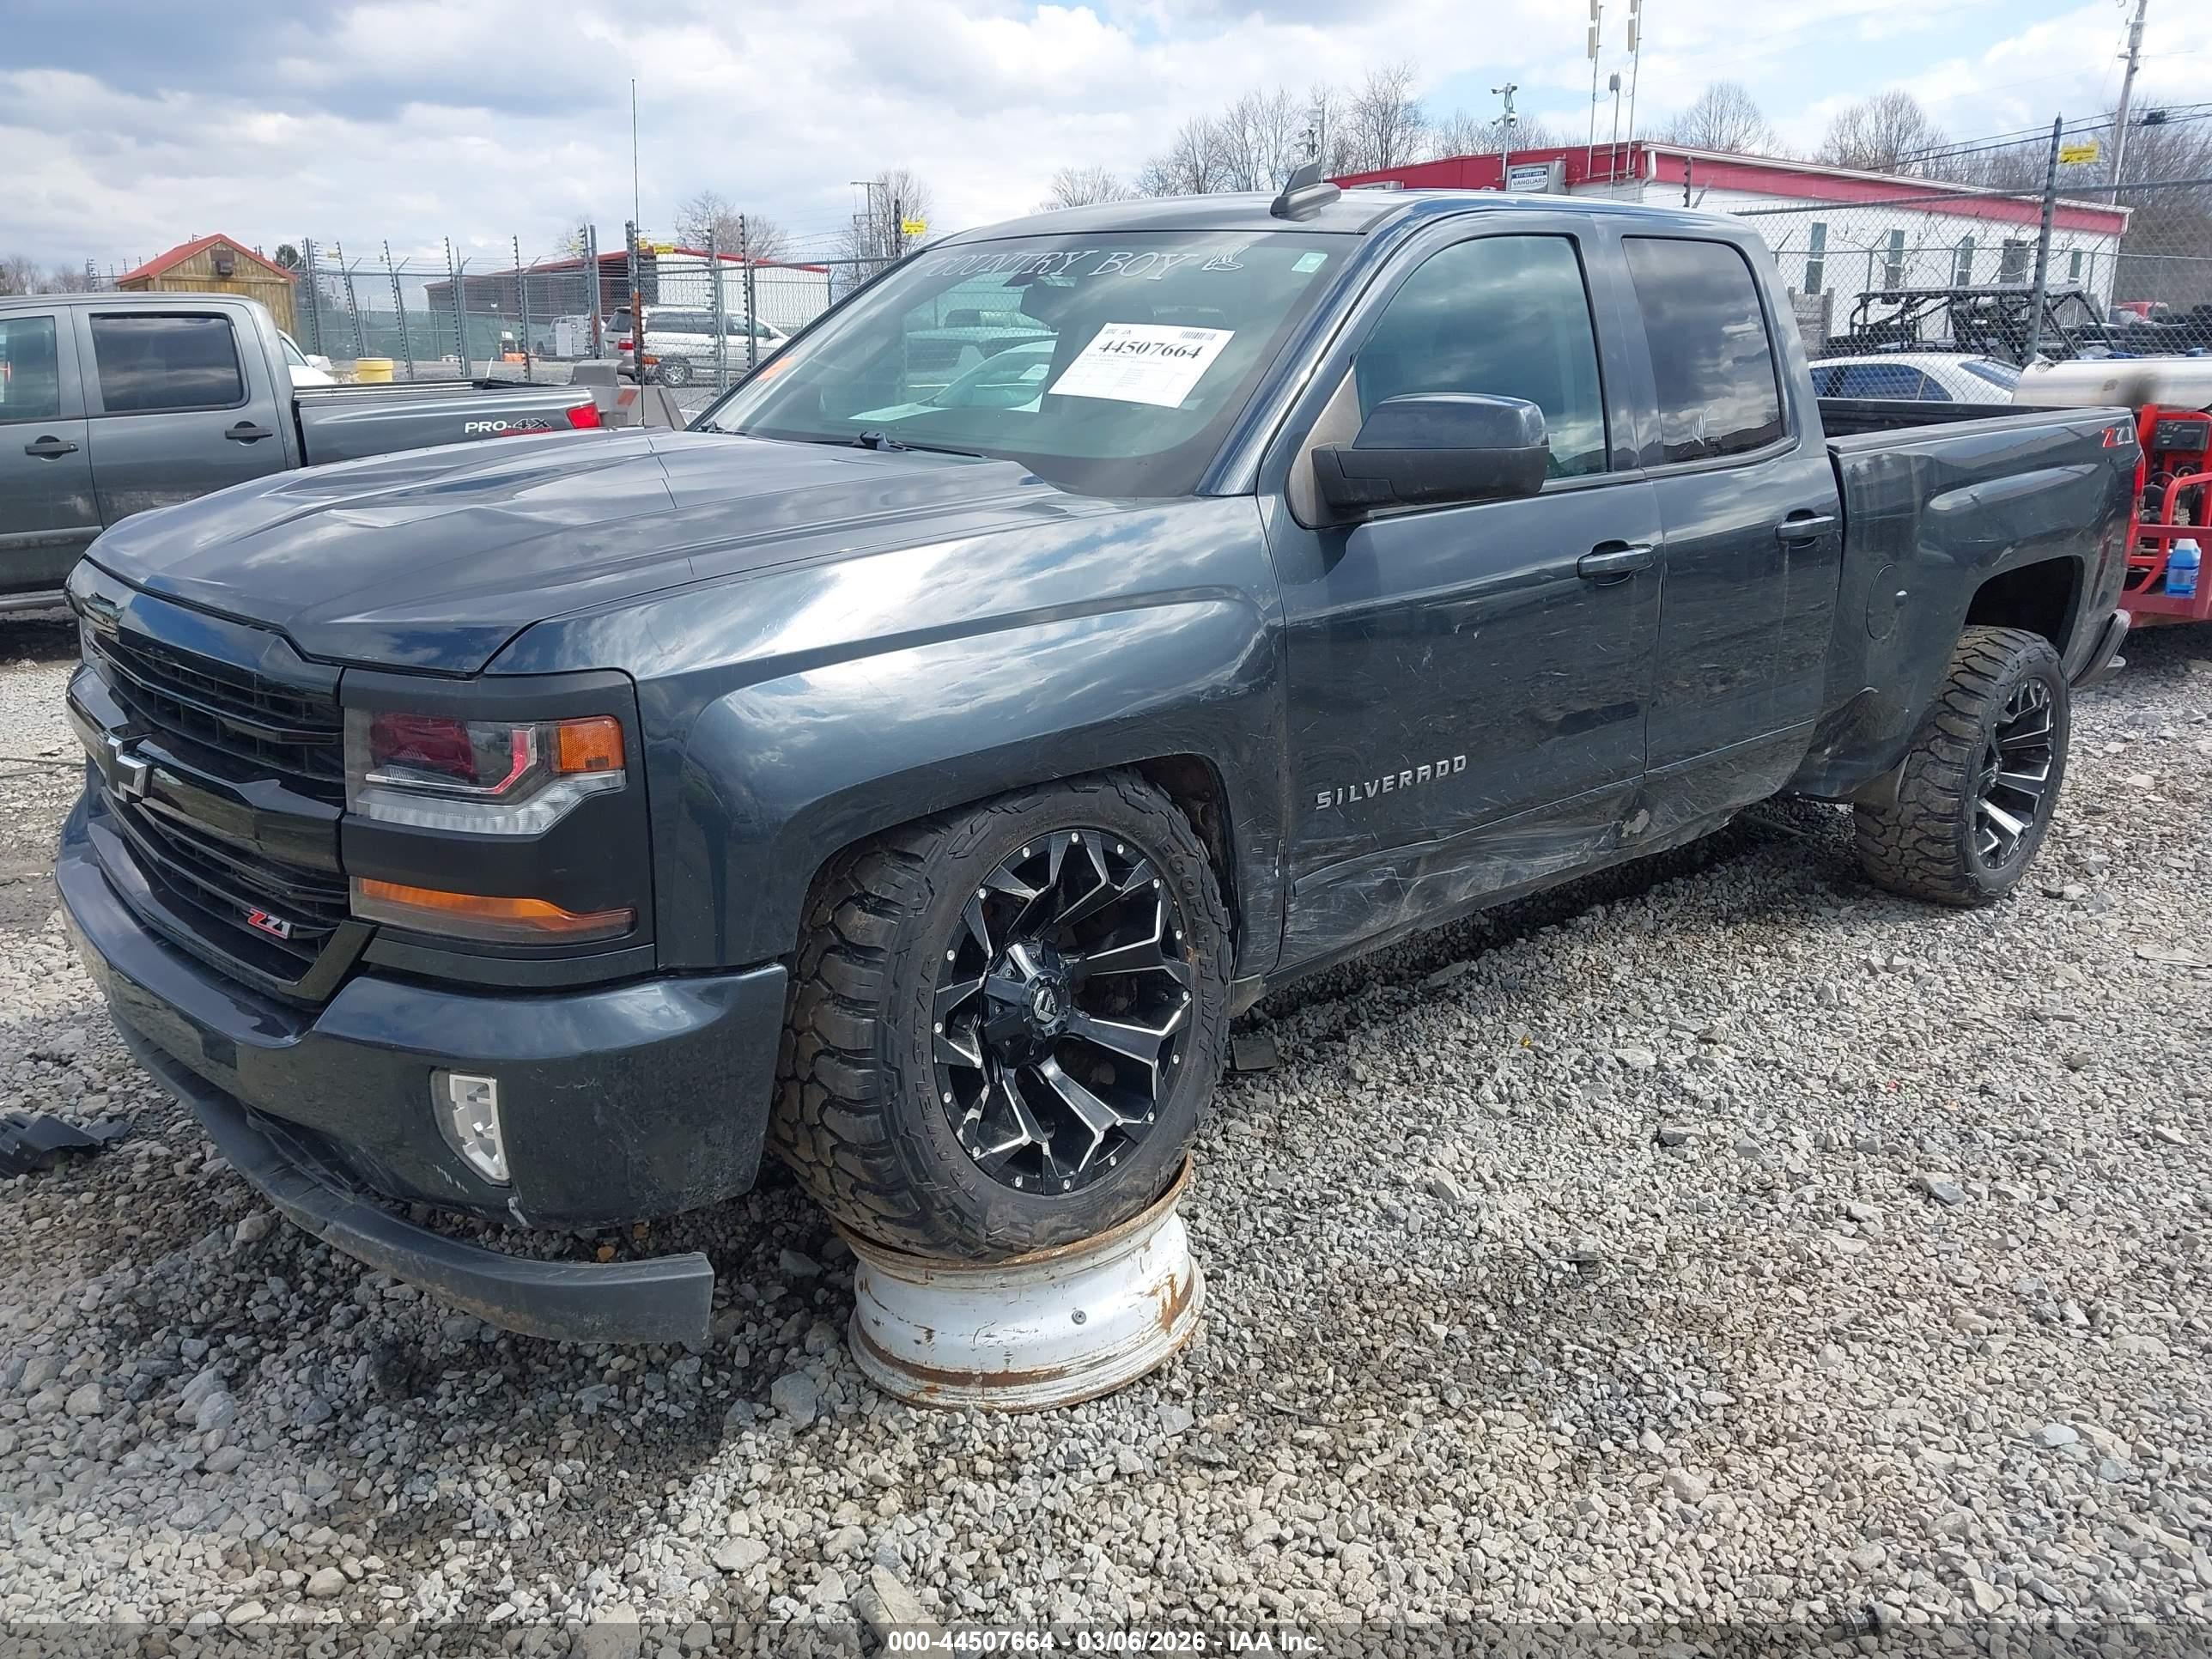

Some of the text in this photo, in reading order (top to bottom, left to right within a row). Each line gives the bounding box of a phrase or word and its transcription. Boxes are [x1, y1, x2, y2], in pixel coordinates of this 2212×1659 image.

[1088, 252, 1200, 281] BOY
[1098, 340, 1204, 359] 44507664
[465, 417, 552, 434] PRO-4X
[2101, 426, 2135, 447] Z71
[1316, 755, 1468, 811] SILVERADO
[246, 907, 291, 940] Z71
